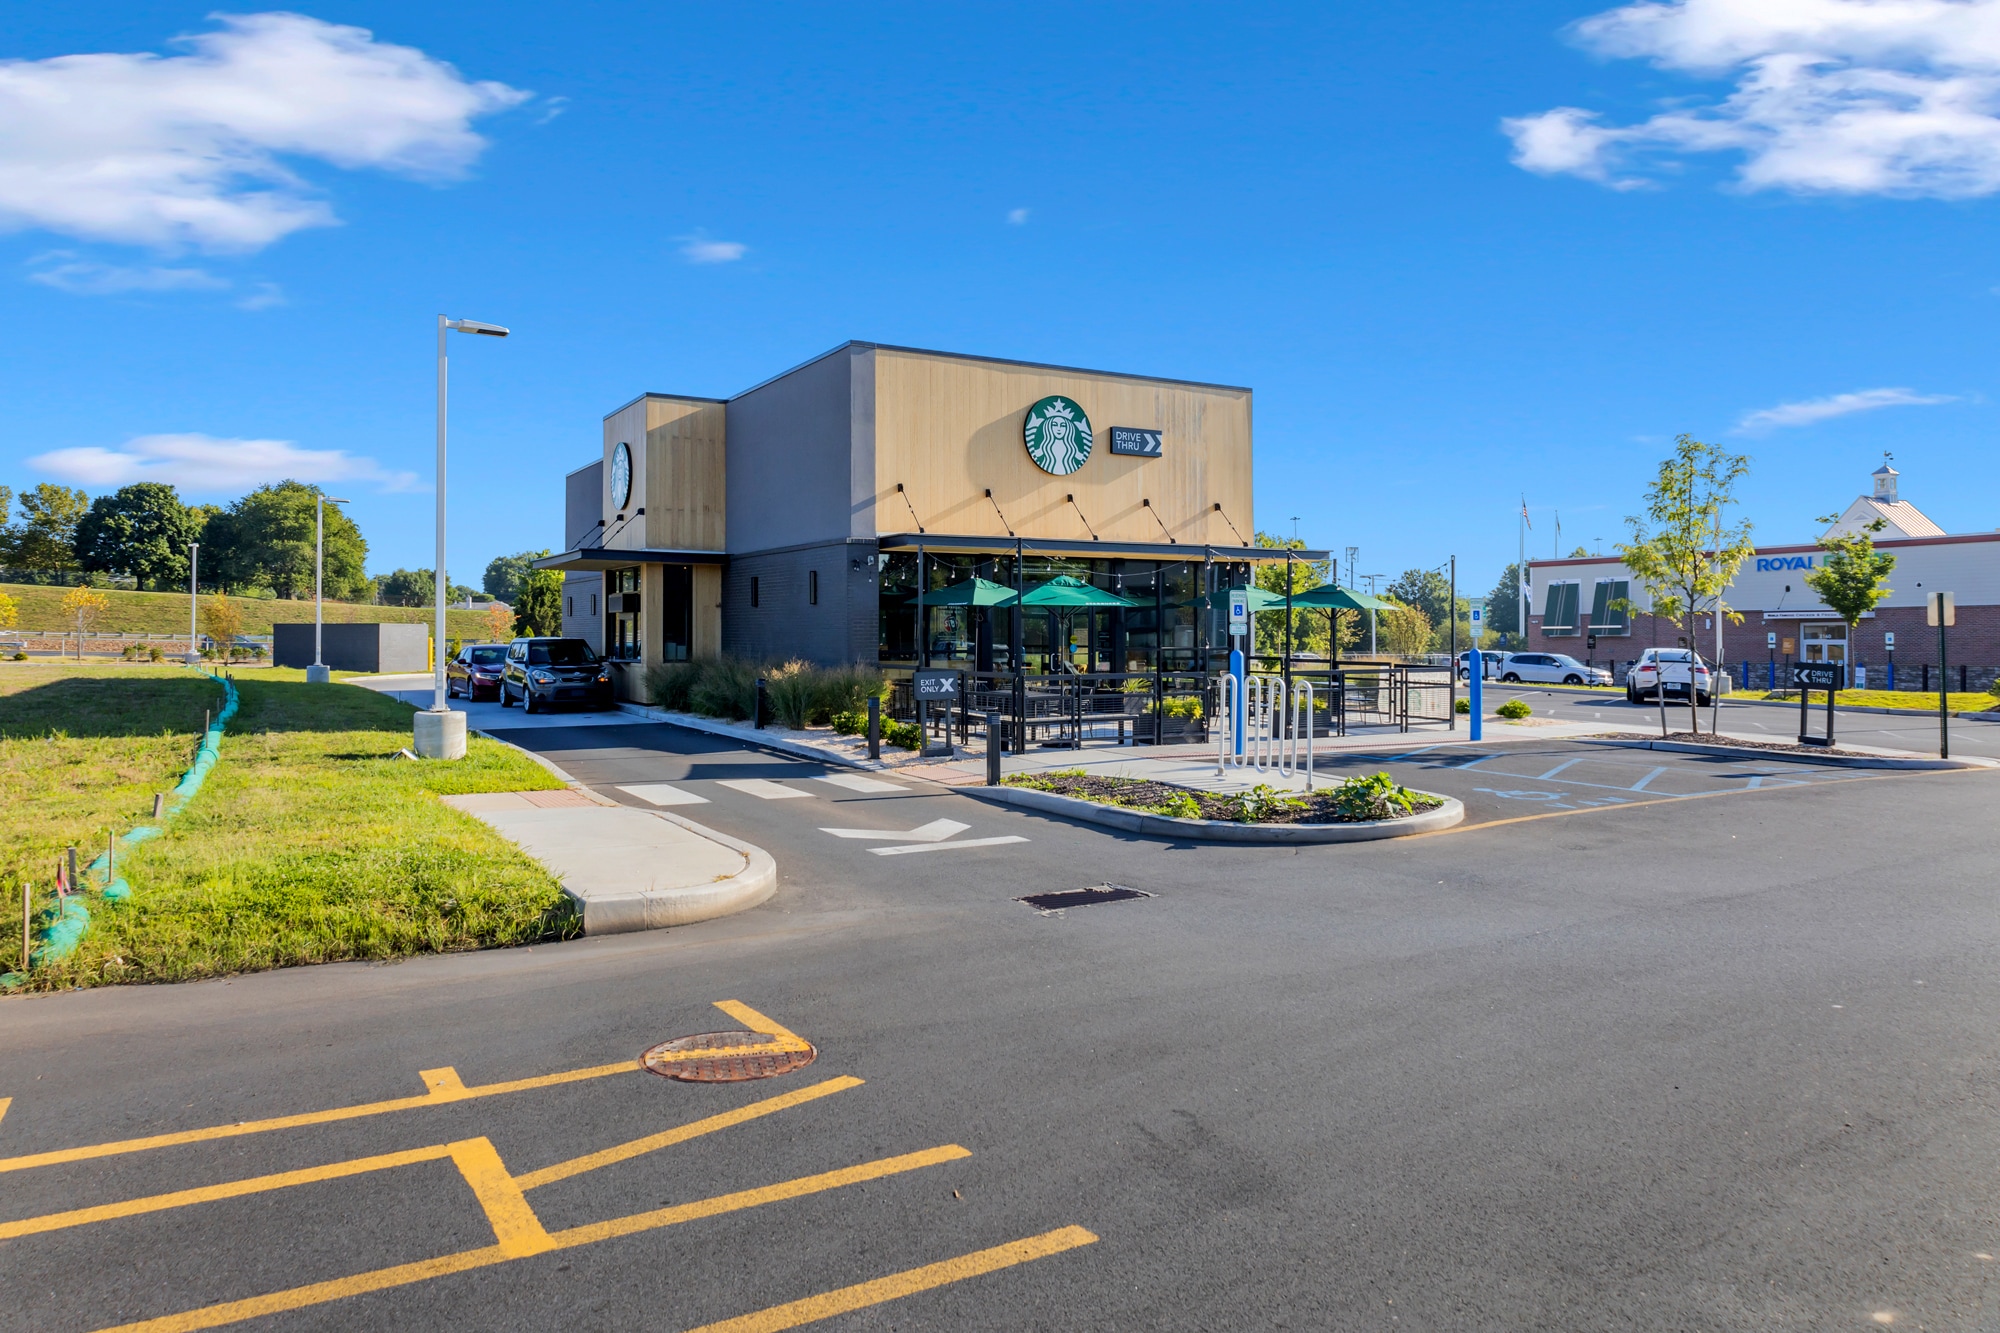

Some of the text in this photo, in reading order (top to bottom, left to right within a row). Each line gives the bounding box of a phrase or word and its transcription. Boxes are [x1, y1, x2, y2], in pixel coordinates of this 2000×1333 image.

[1116, 431, 1141, 441] DRIVE
[1116, 441, 1140, 450] THRU
[1757, 556, 1813, 572] ROYAL
